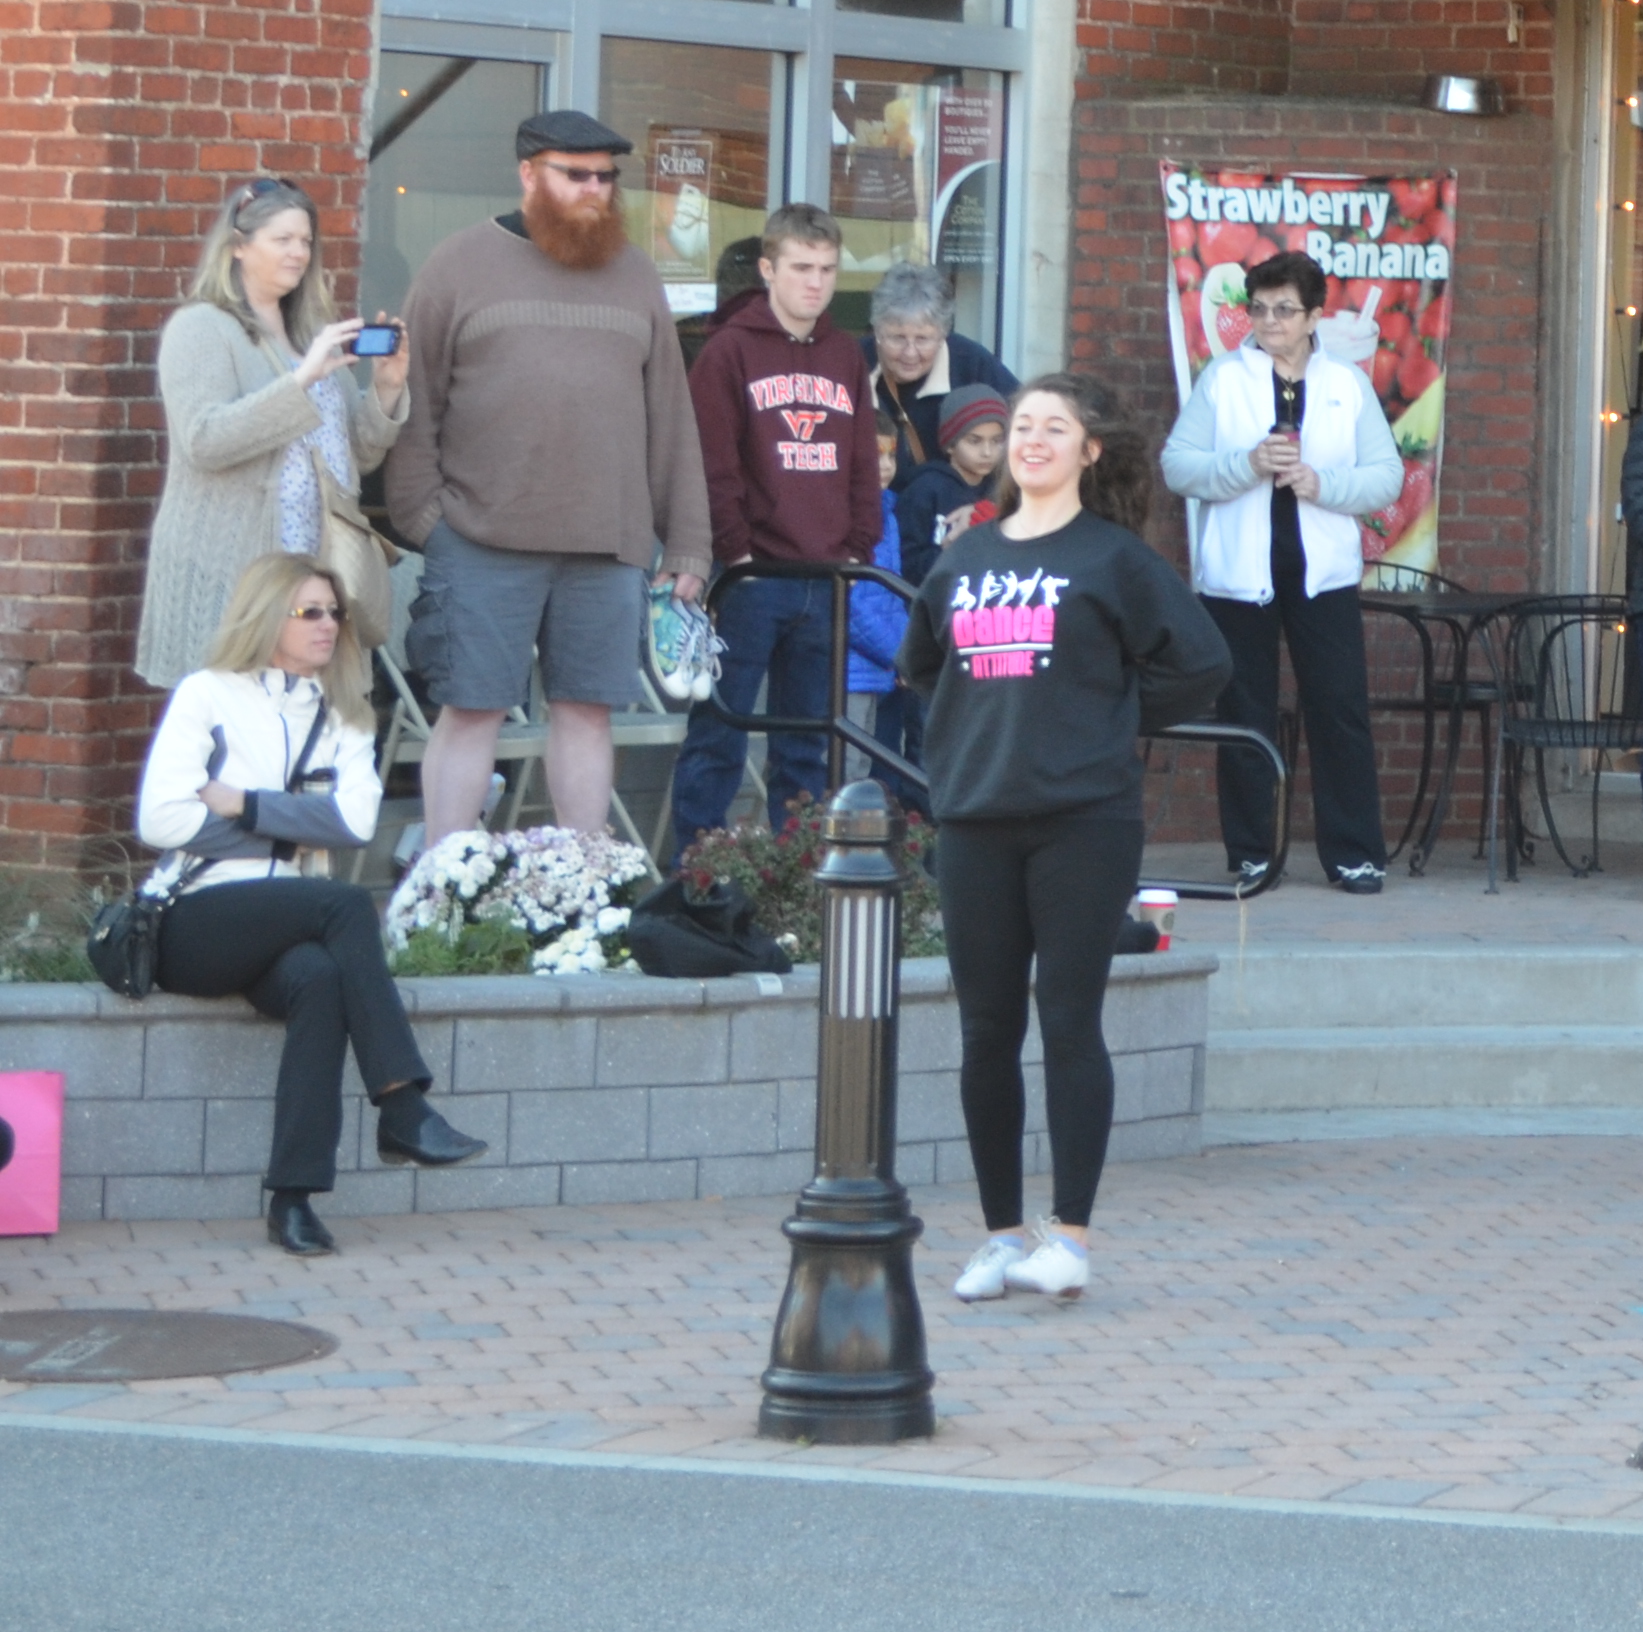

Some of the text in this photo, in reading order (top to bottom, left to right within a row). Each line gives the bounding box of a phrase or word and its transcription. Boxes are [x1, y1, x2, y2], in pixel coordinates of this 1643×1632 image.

[1165, 171, 1391, 238] Strawberry
[1306, 231, 1450, 280] Banana
[749, 373, 854, 416] VIRGINIA
[780, 409, 828, 441] VT
[777, 441, 839, 471] TECH
